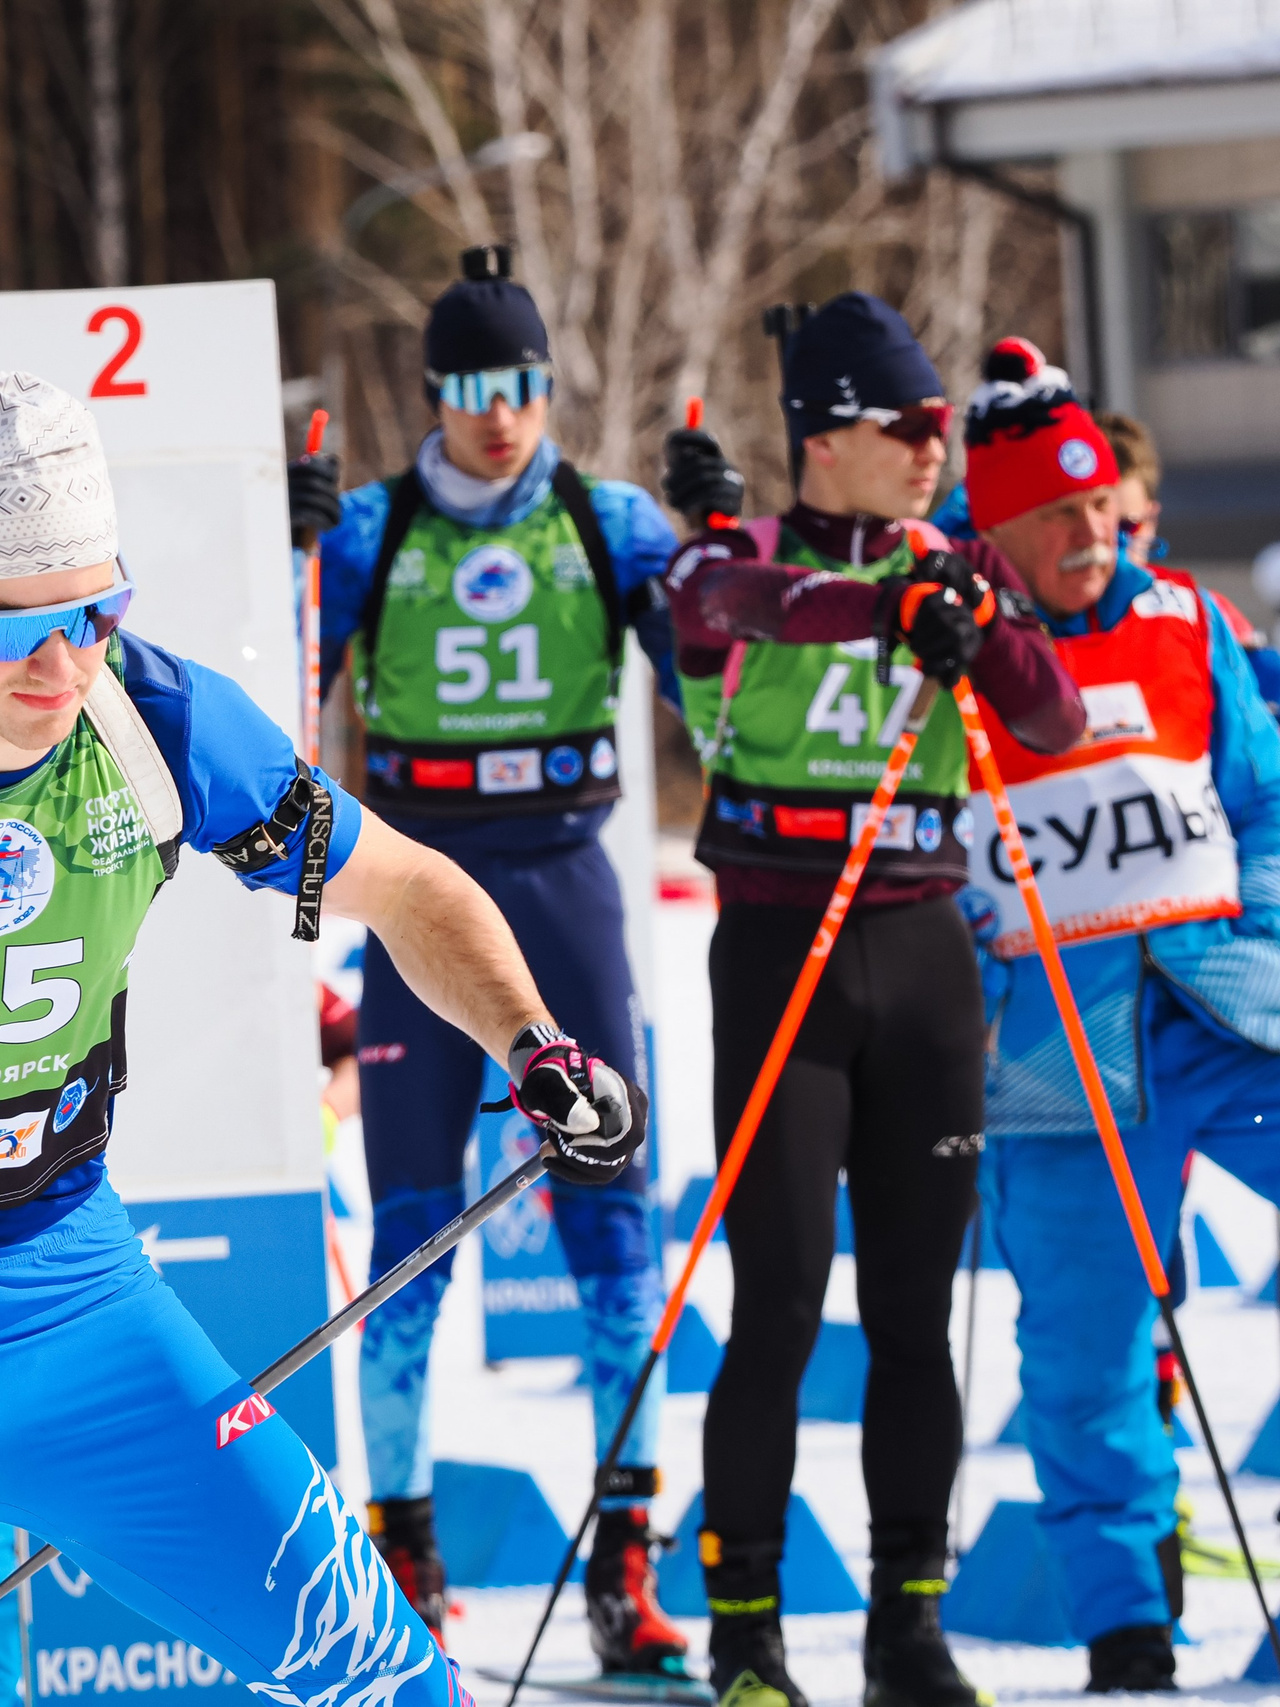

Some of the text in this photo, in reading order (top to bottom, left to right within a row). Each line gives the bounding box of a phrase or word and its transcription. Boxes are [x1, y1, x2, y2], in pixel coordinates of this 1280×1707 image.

[87, 306, 146, 398] 2
[435, 623, 553, 704] 51
[805, 663, 924, 747] 47
[85, 787, 130, 815] СПОРТ
[5, 821, 43, 847] РОССИИ
[90, 822, 149, 855] ЖИЗНИ
[93, 860, 124, 877] ПРОЕКТ
[13, 905, 36, 925] 2023
[36, 1640, 238, 1698] КРАСНО
